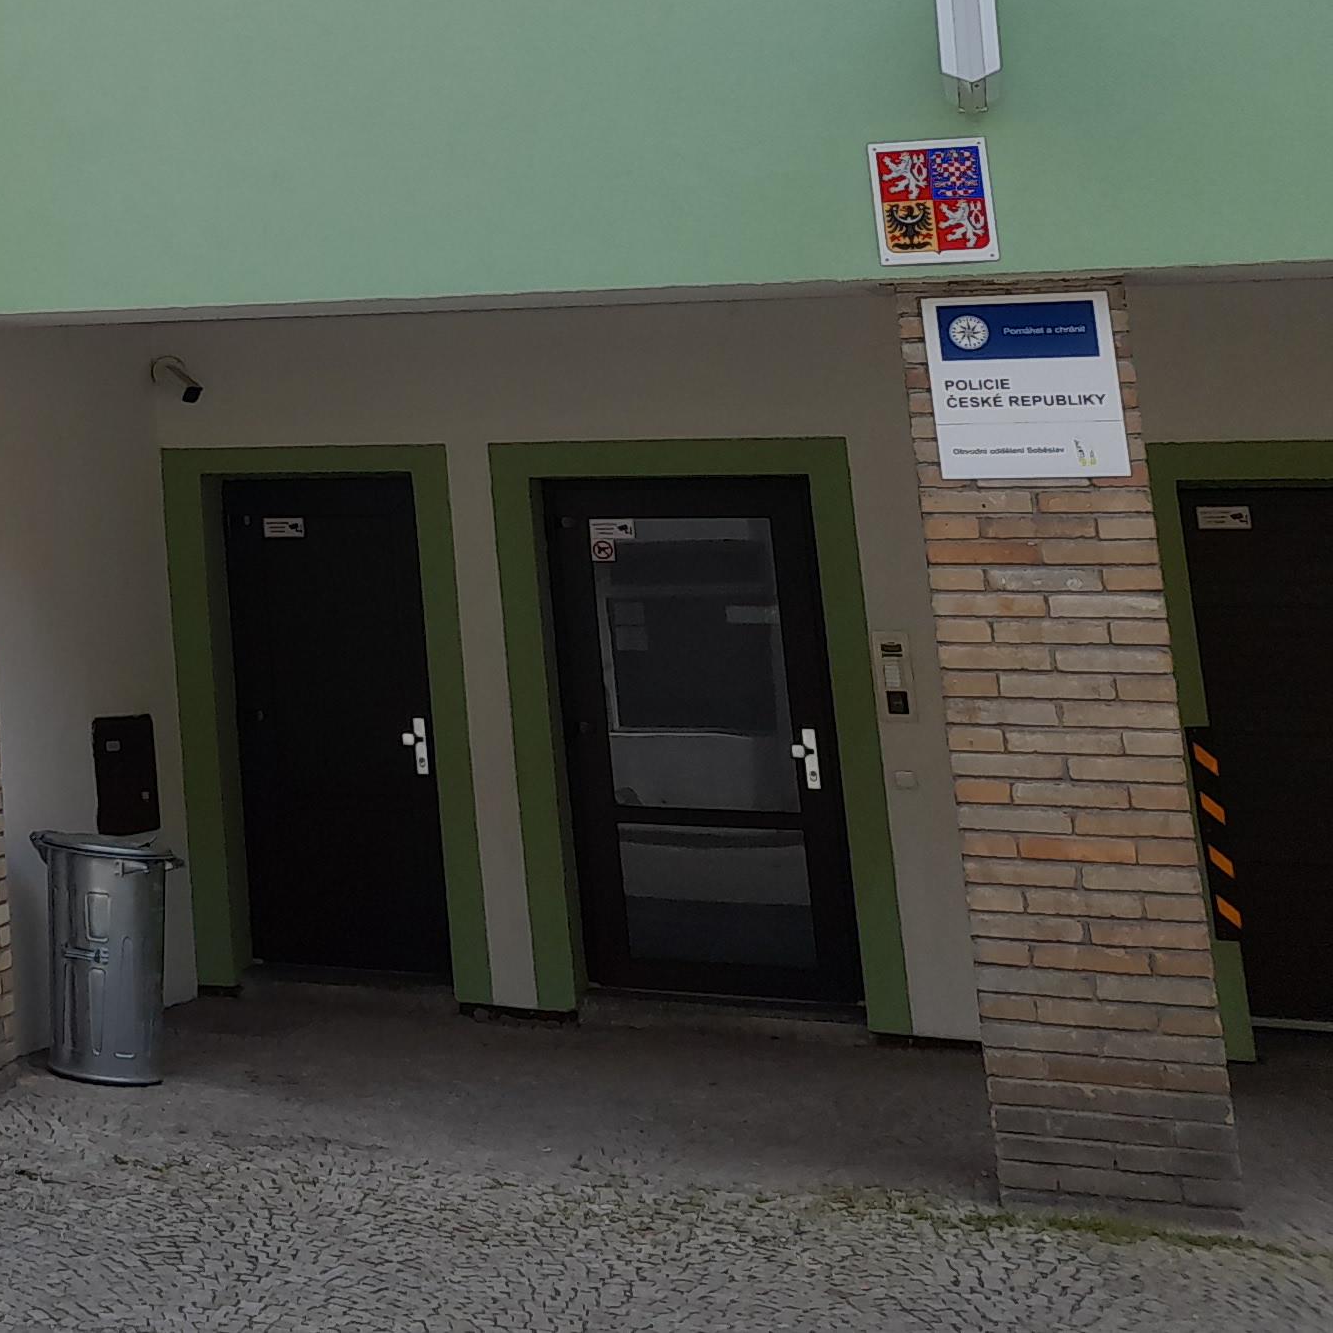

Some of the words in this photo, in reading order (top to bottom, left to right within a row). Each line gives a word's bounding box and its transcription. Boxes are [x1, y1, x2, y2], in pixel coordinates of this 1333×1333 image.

[944, 378, 1011, 392] POLICIE
[946, 392, 1004, 409] ČESKÉ
[1008, 393, 1107, 408] REPUBLIKY
